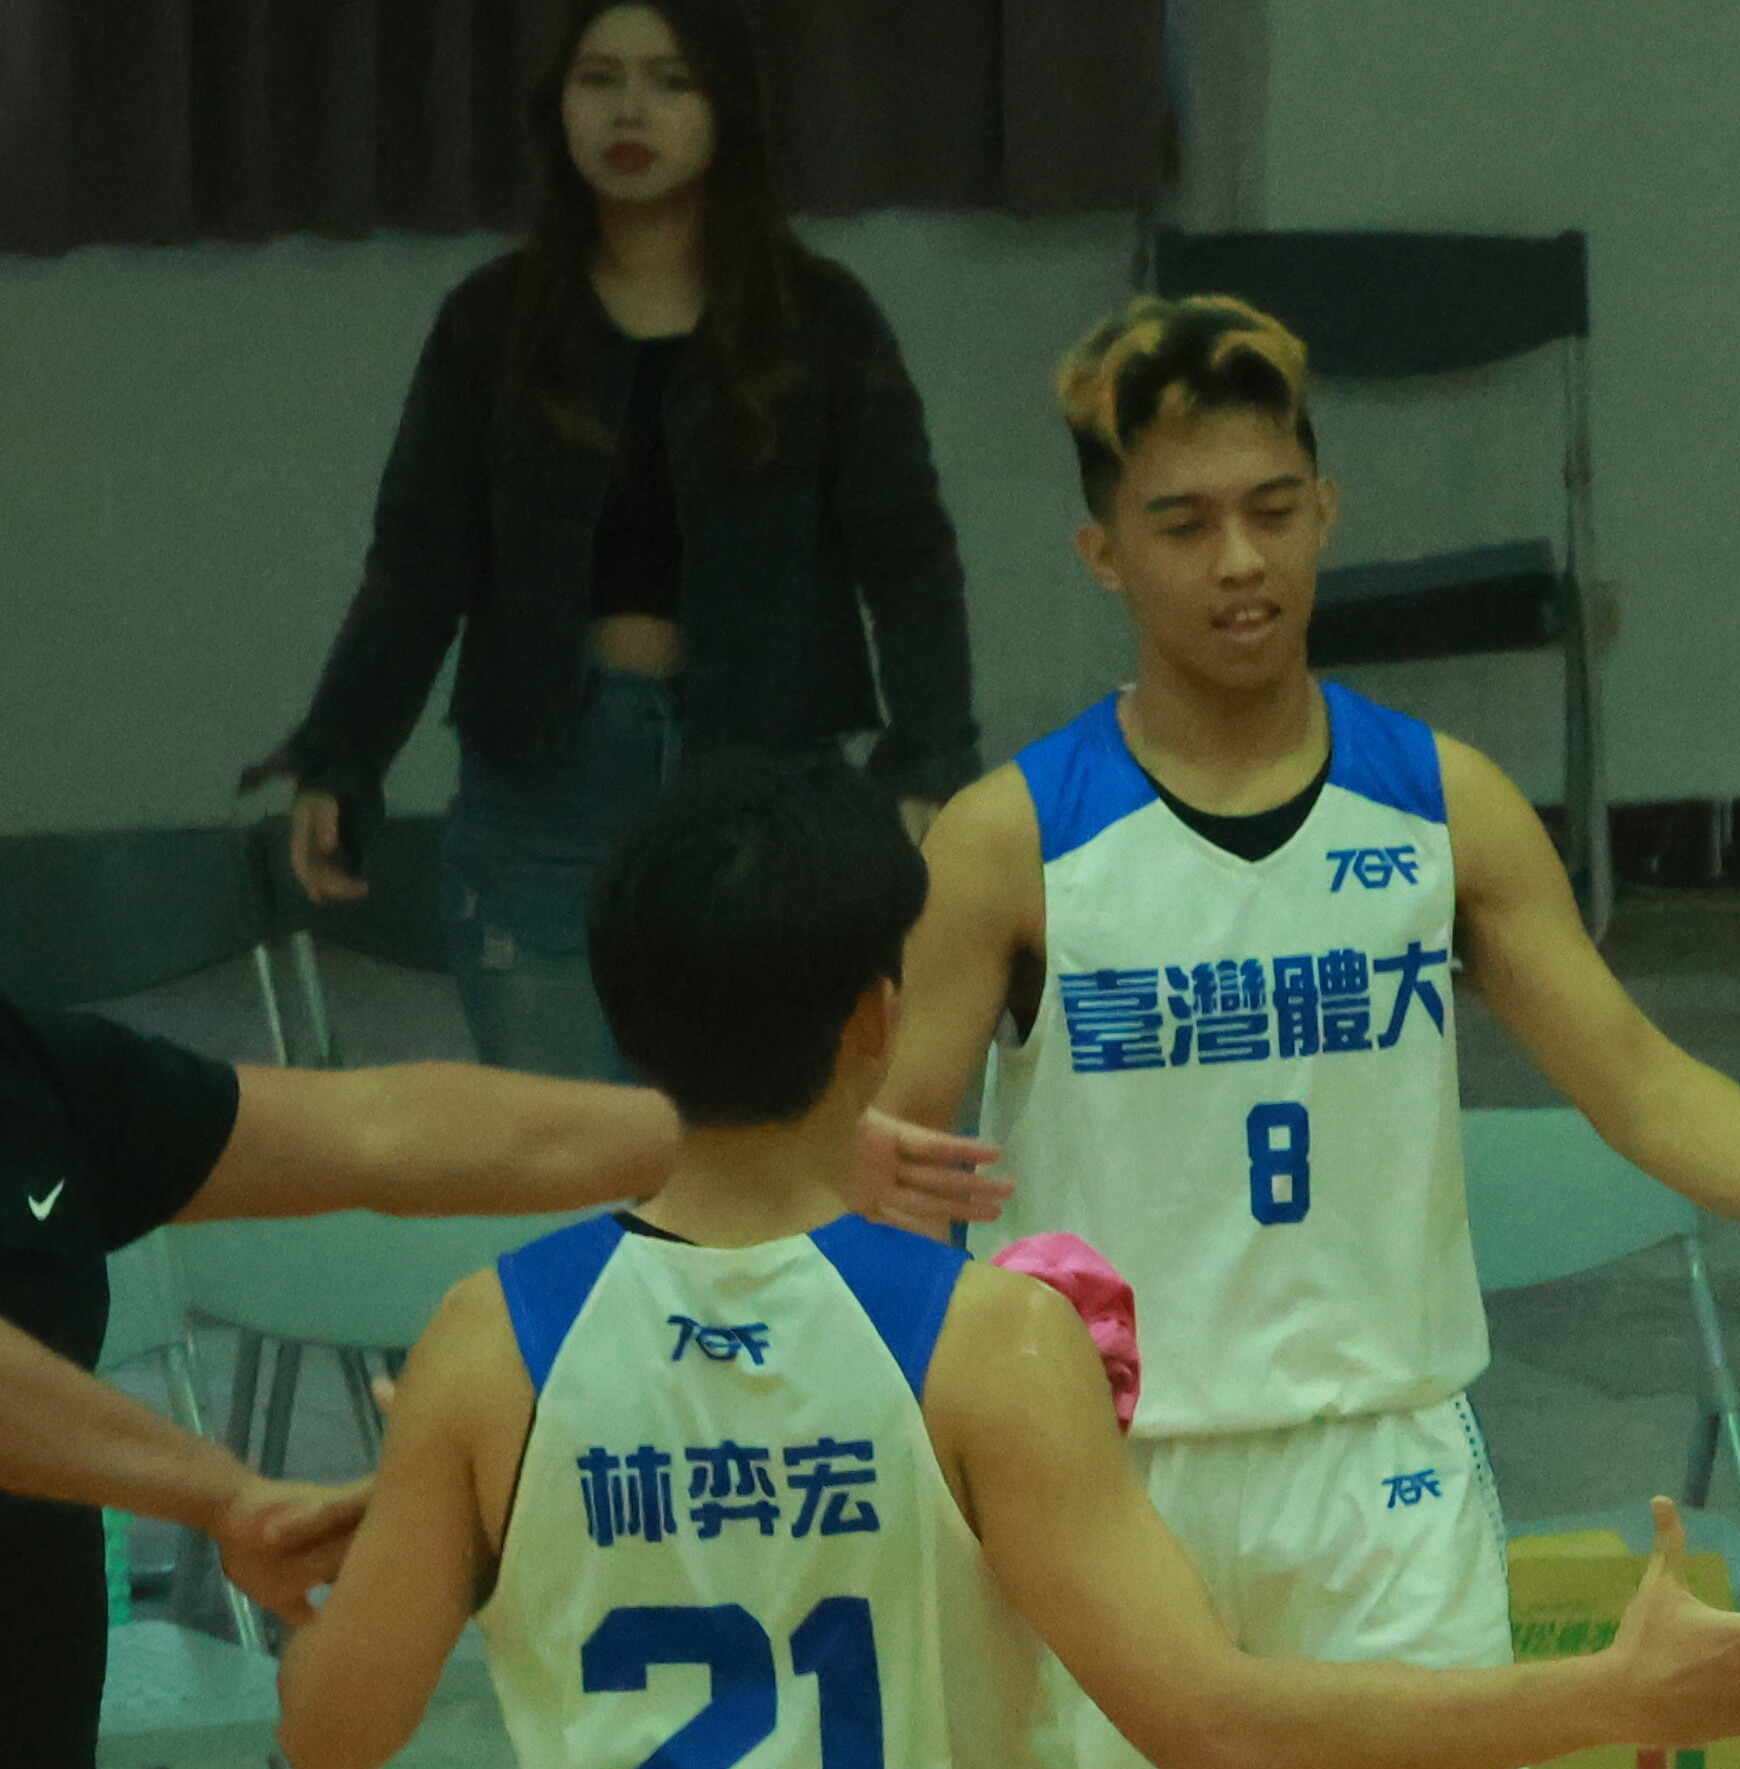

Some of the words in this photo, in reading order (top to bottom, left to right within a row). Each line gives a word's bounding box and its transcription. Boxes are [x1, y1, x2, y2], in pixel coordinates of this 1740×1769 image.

[1057, 939, 1449, 1074] 臺灣體大
[1246, 1101, 1312, 1228] 8
[577, 1436, 881, 1548] 林弈宏
